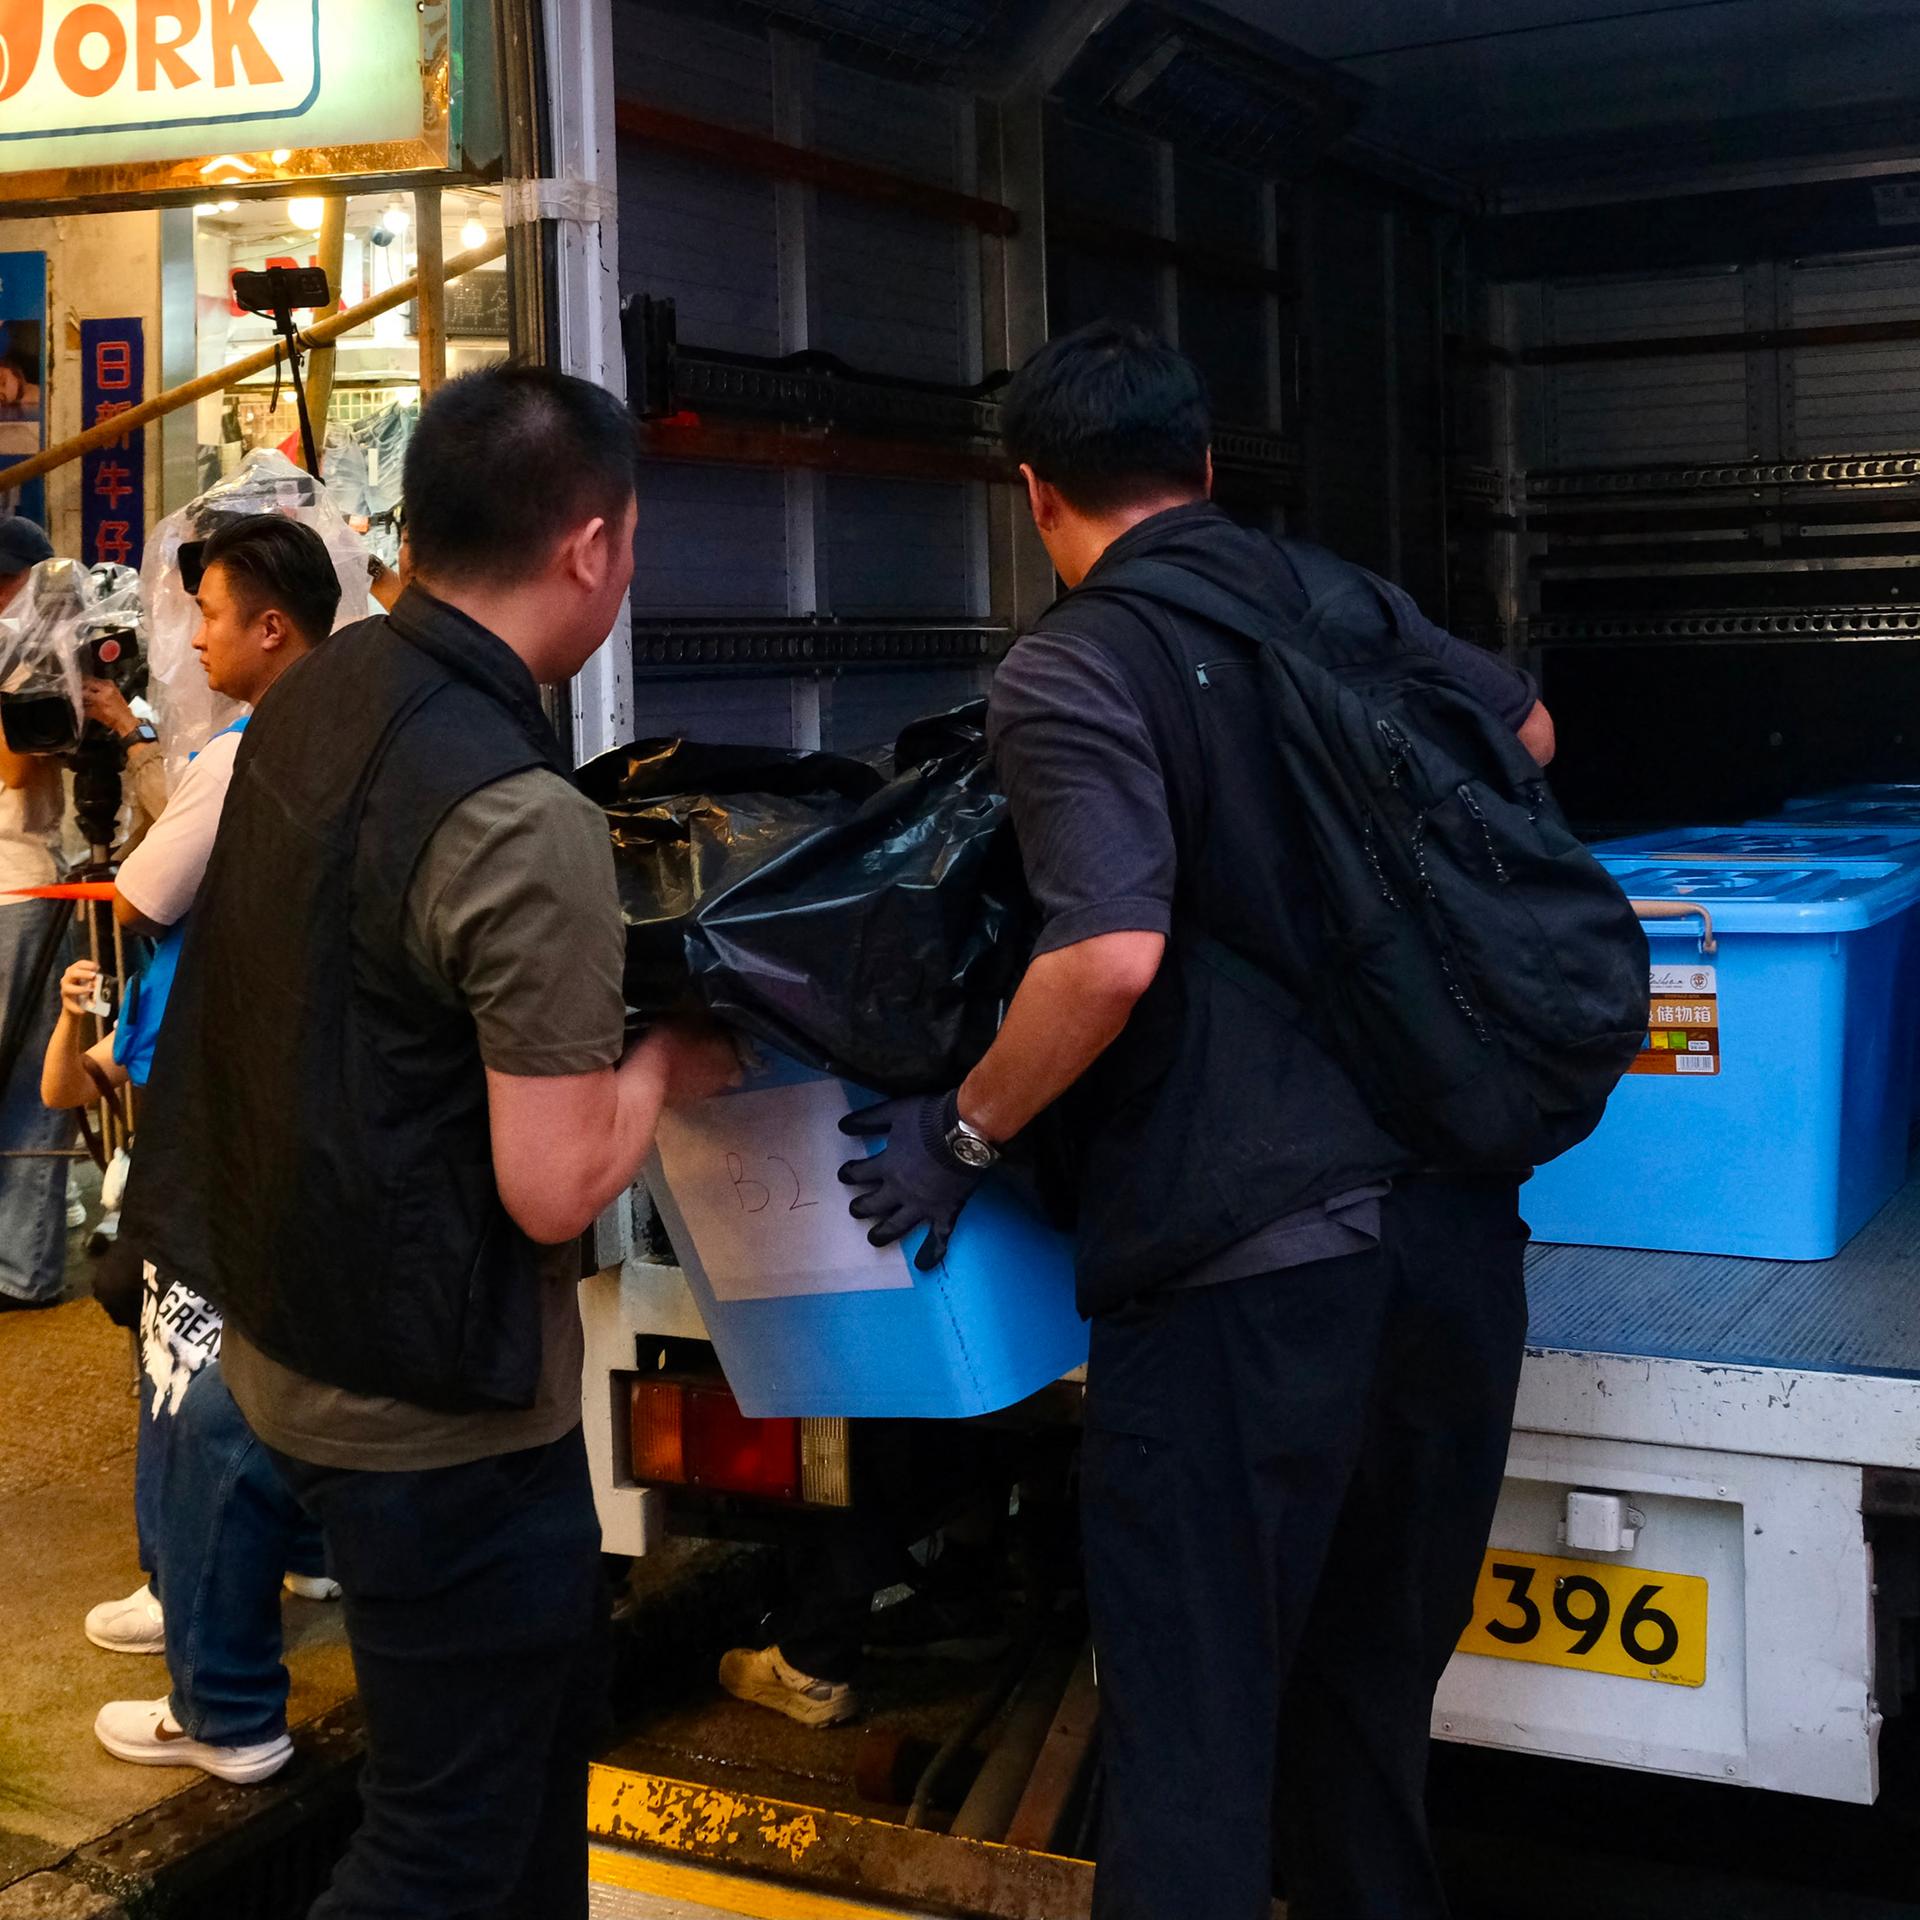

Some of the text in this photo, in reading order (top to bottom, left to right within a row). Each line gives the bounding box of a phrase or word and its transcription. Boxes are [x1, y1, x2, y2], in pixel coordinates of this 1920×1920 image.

[726, 1152, 819, 1213] B2
[158, 1290, 221, 1358] GREA
[1485, 1563, 1679, 1665] 396
